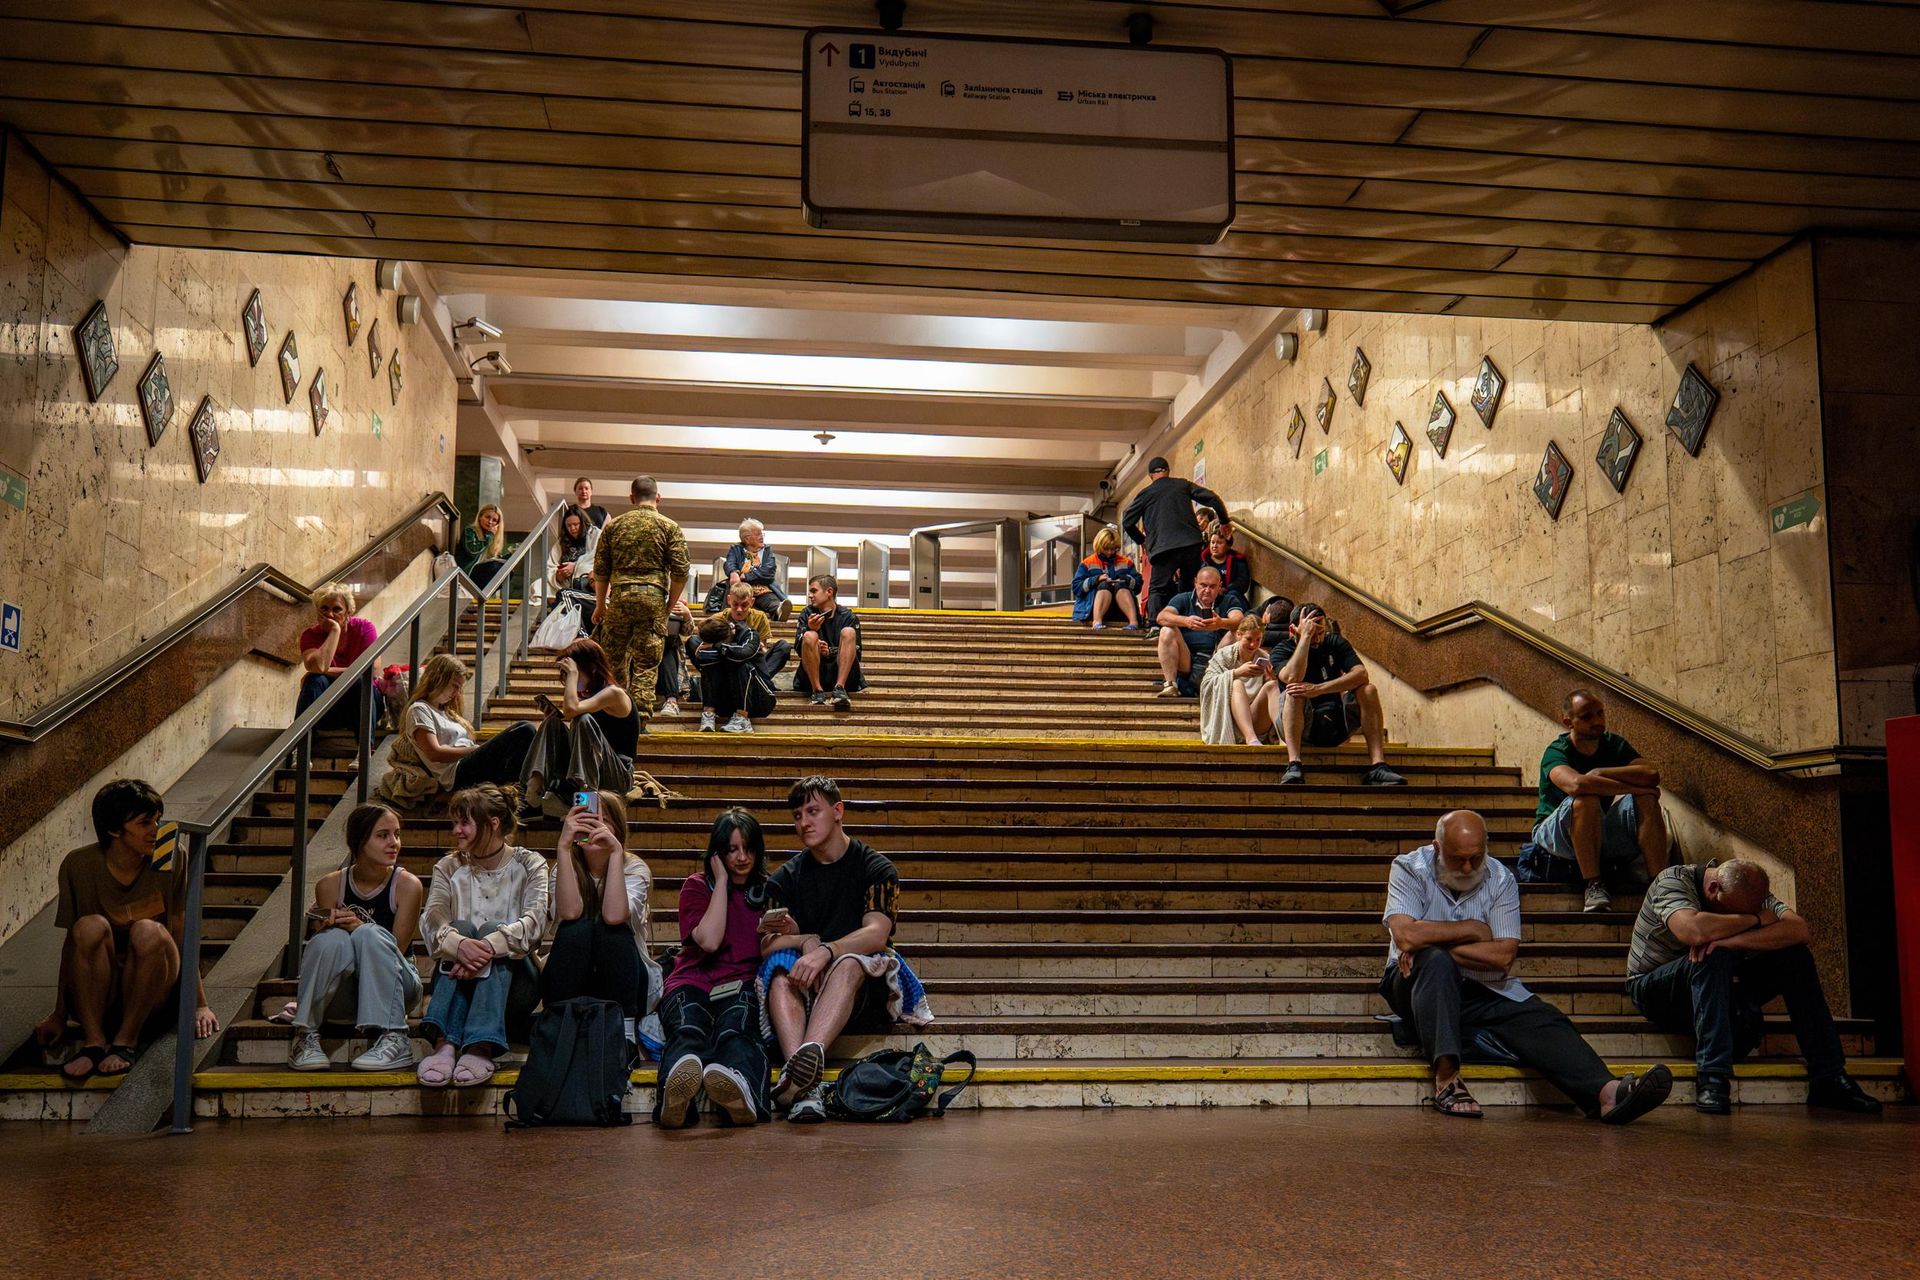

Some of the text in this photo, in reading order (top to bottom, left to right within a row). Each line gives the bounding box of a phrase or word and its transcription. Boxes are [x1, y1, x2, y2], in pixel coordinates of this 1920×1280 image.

[857, 48, 866, 65] 1
[878, 46, 927, 59] Видубичі
[879, 58, 920, 68] Vydubychi
[872, 79, 926, 90] Автостанція
[963, 83, 1043, 96] Залізнична станція
[885, 88, 908, 96] Station
[1077, 89, 1157, 102] Міська електричка
[865, 108, 891, 118] 15, 38
